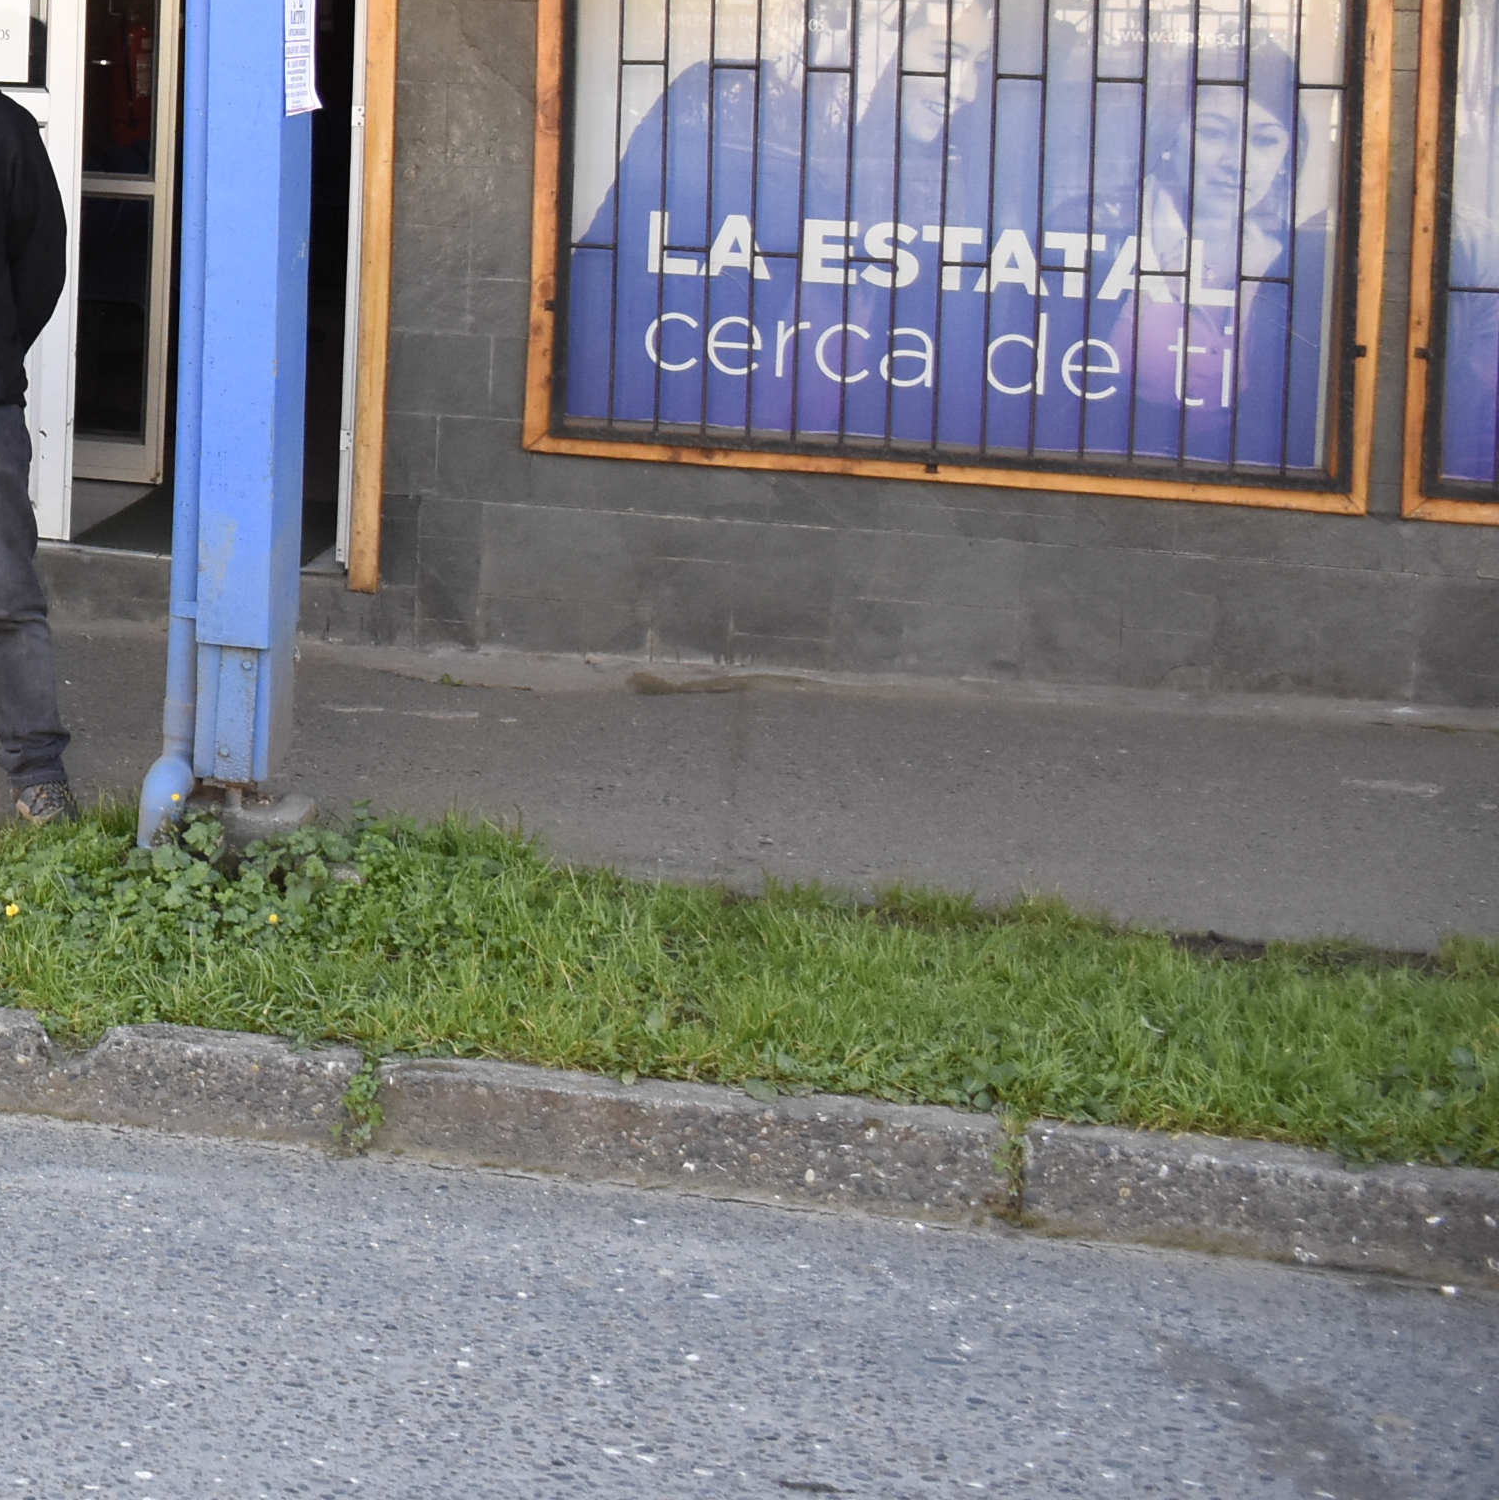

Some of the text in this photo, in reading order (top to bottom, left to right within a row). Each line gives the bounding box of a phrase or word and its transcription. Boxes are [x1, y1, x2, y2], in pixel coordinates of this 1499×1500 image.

[647, 211, 1235, 307] LA ESTATAL
[645, 311, 1234, 408] cerca de ti
